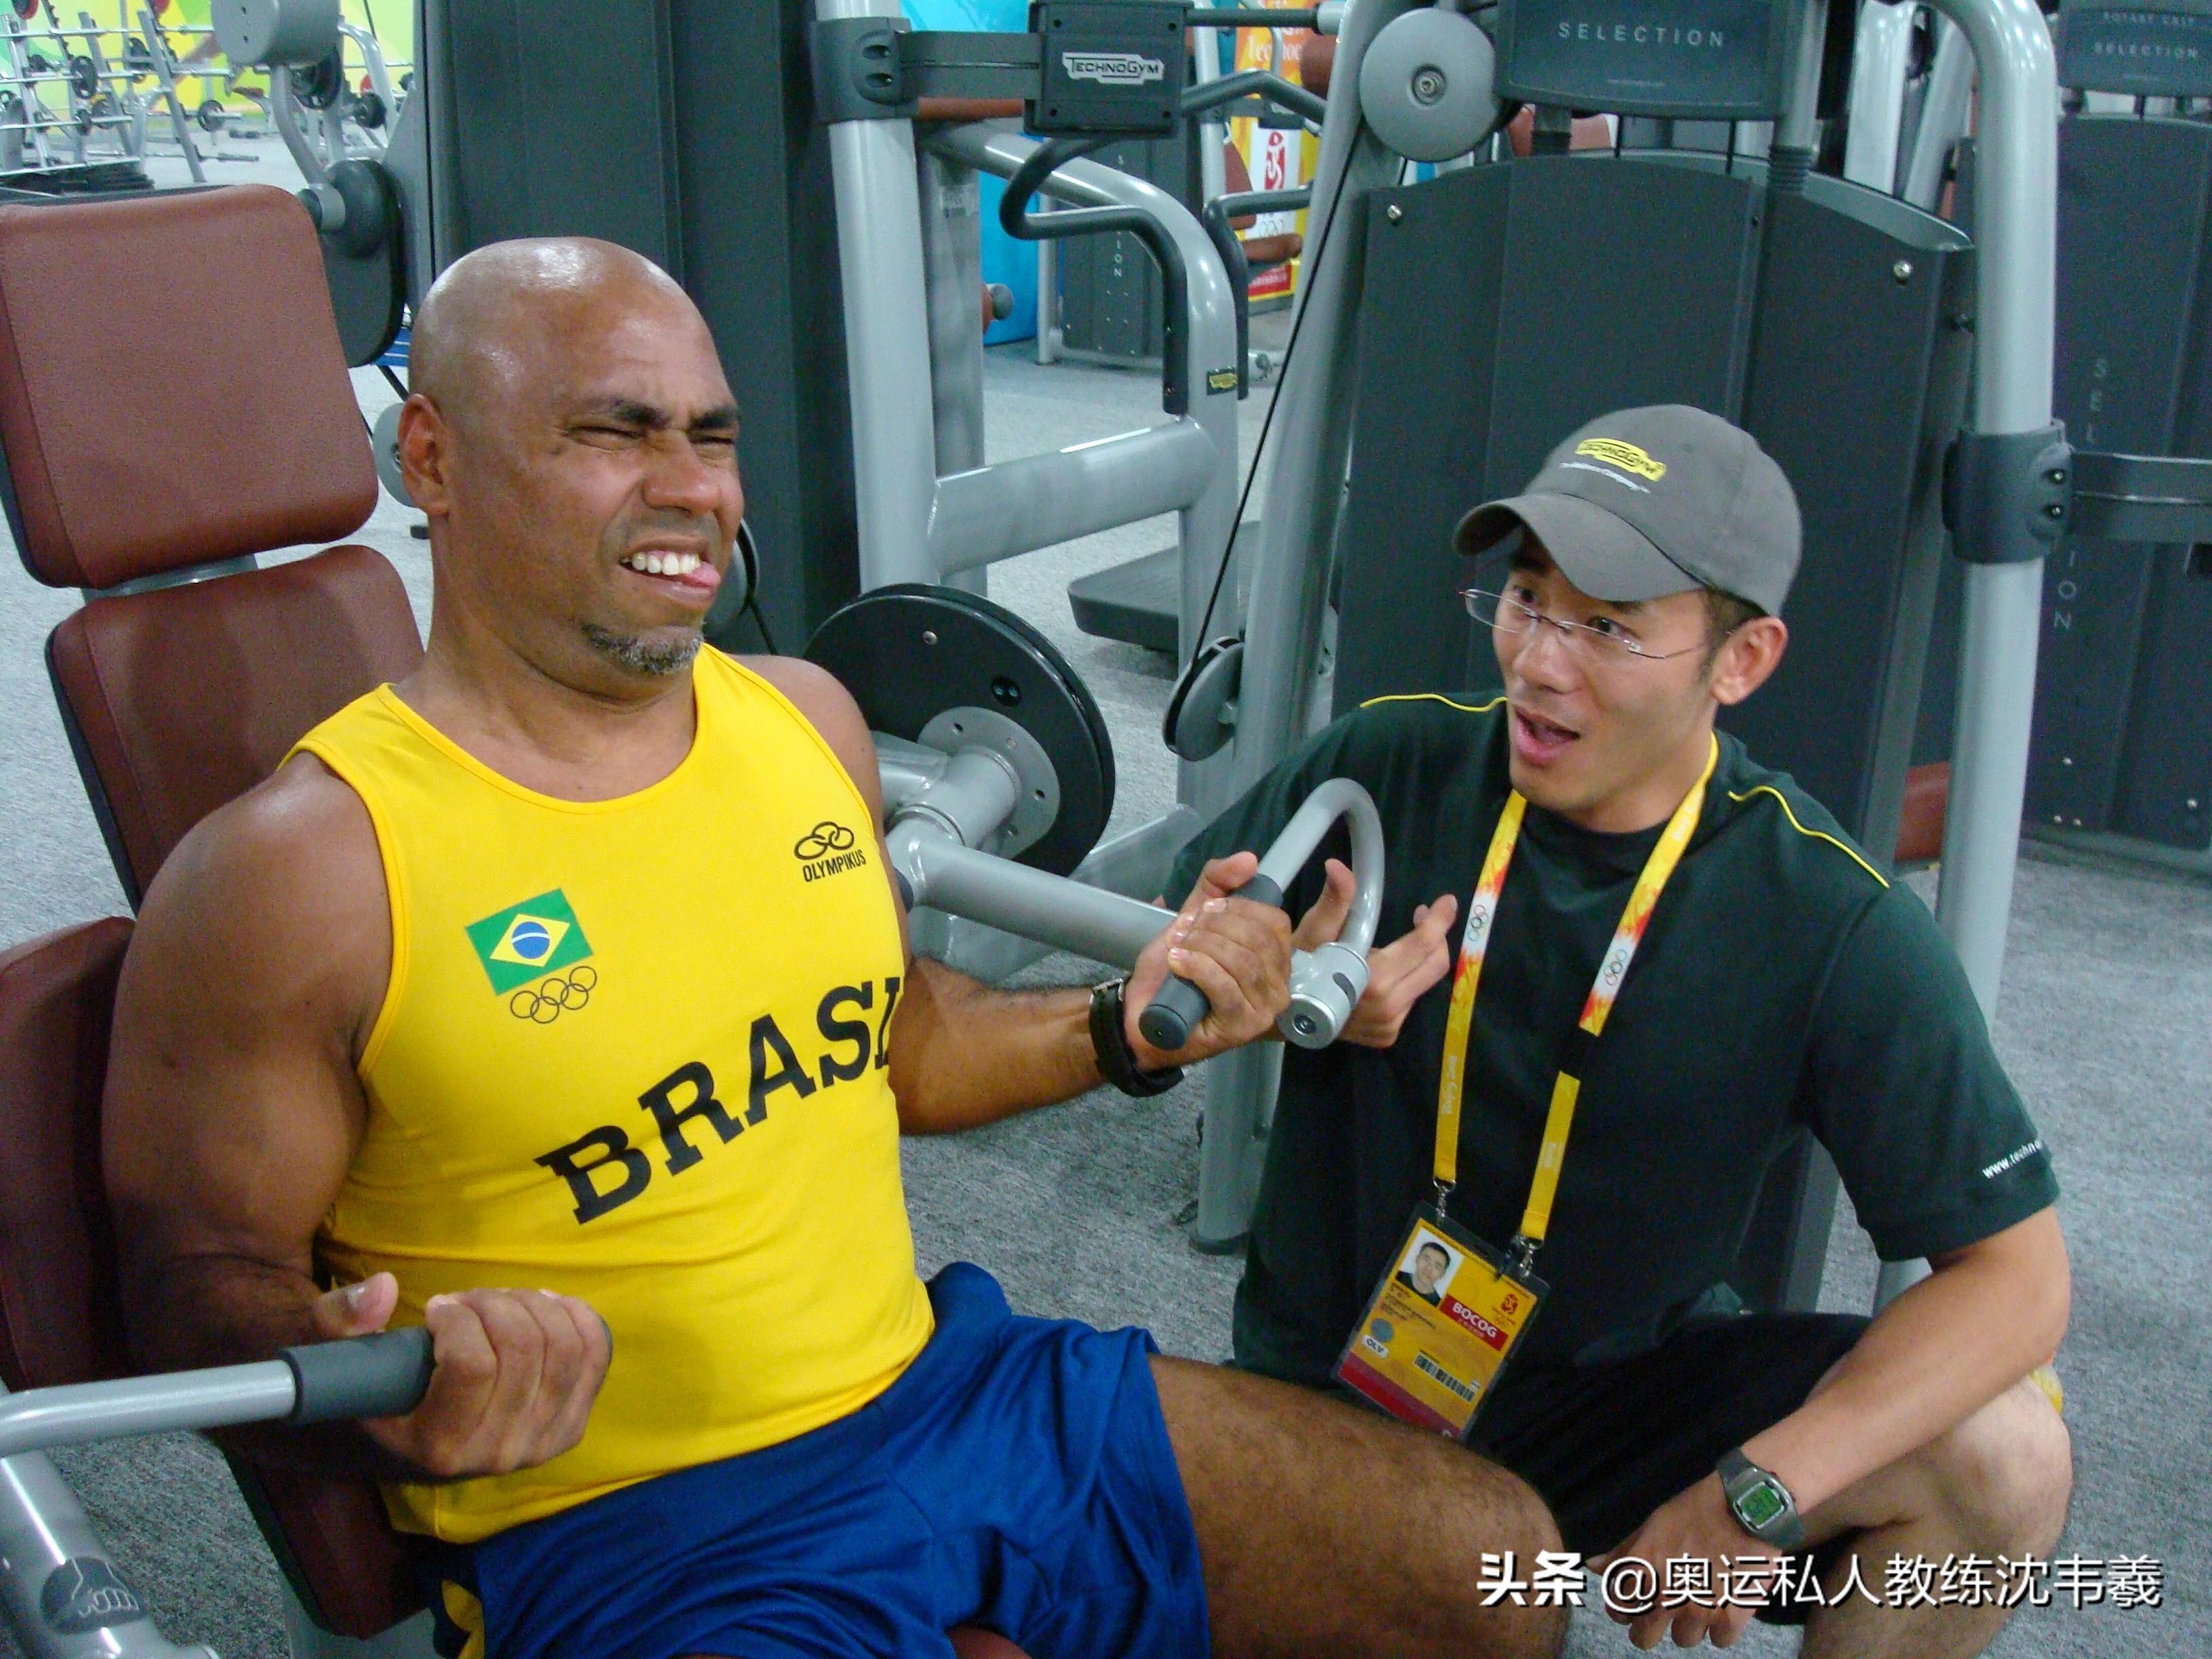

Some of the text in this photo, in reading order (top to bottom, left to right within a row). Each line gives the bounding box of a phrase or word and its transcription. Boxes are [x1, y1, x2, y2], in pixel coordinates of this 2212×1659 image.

[1558, 21, 1724, 47] SELECTION
[2094, 41, 2198, 60] SELECTION
[802, 849, 867, 882] OLYMPIKUS
[534, 976, 901, 1225] BRASI
[1452, 1301, 1498, 1338] BOCOG
[1366, 1337, 1385, 1353] OLV
